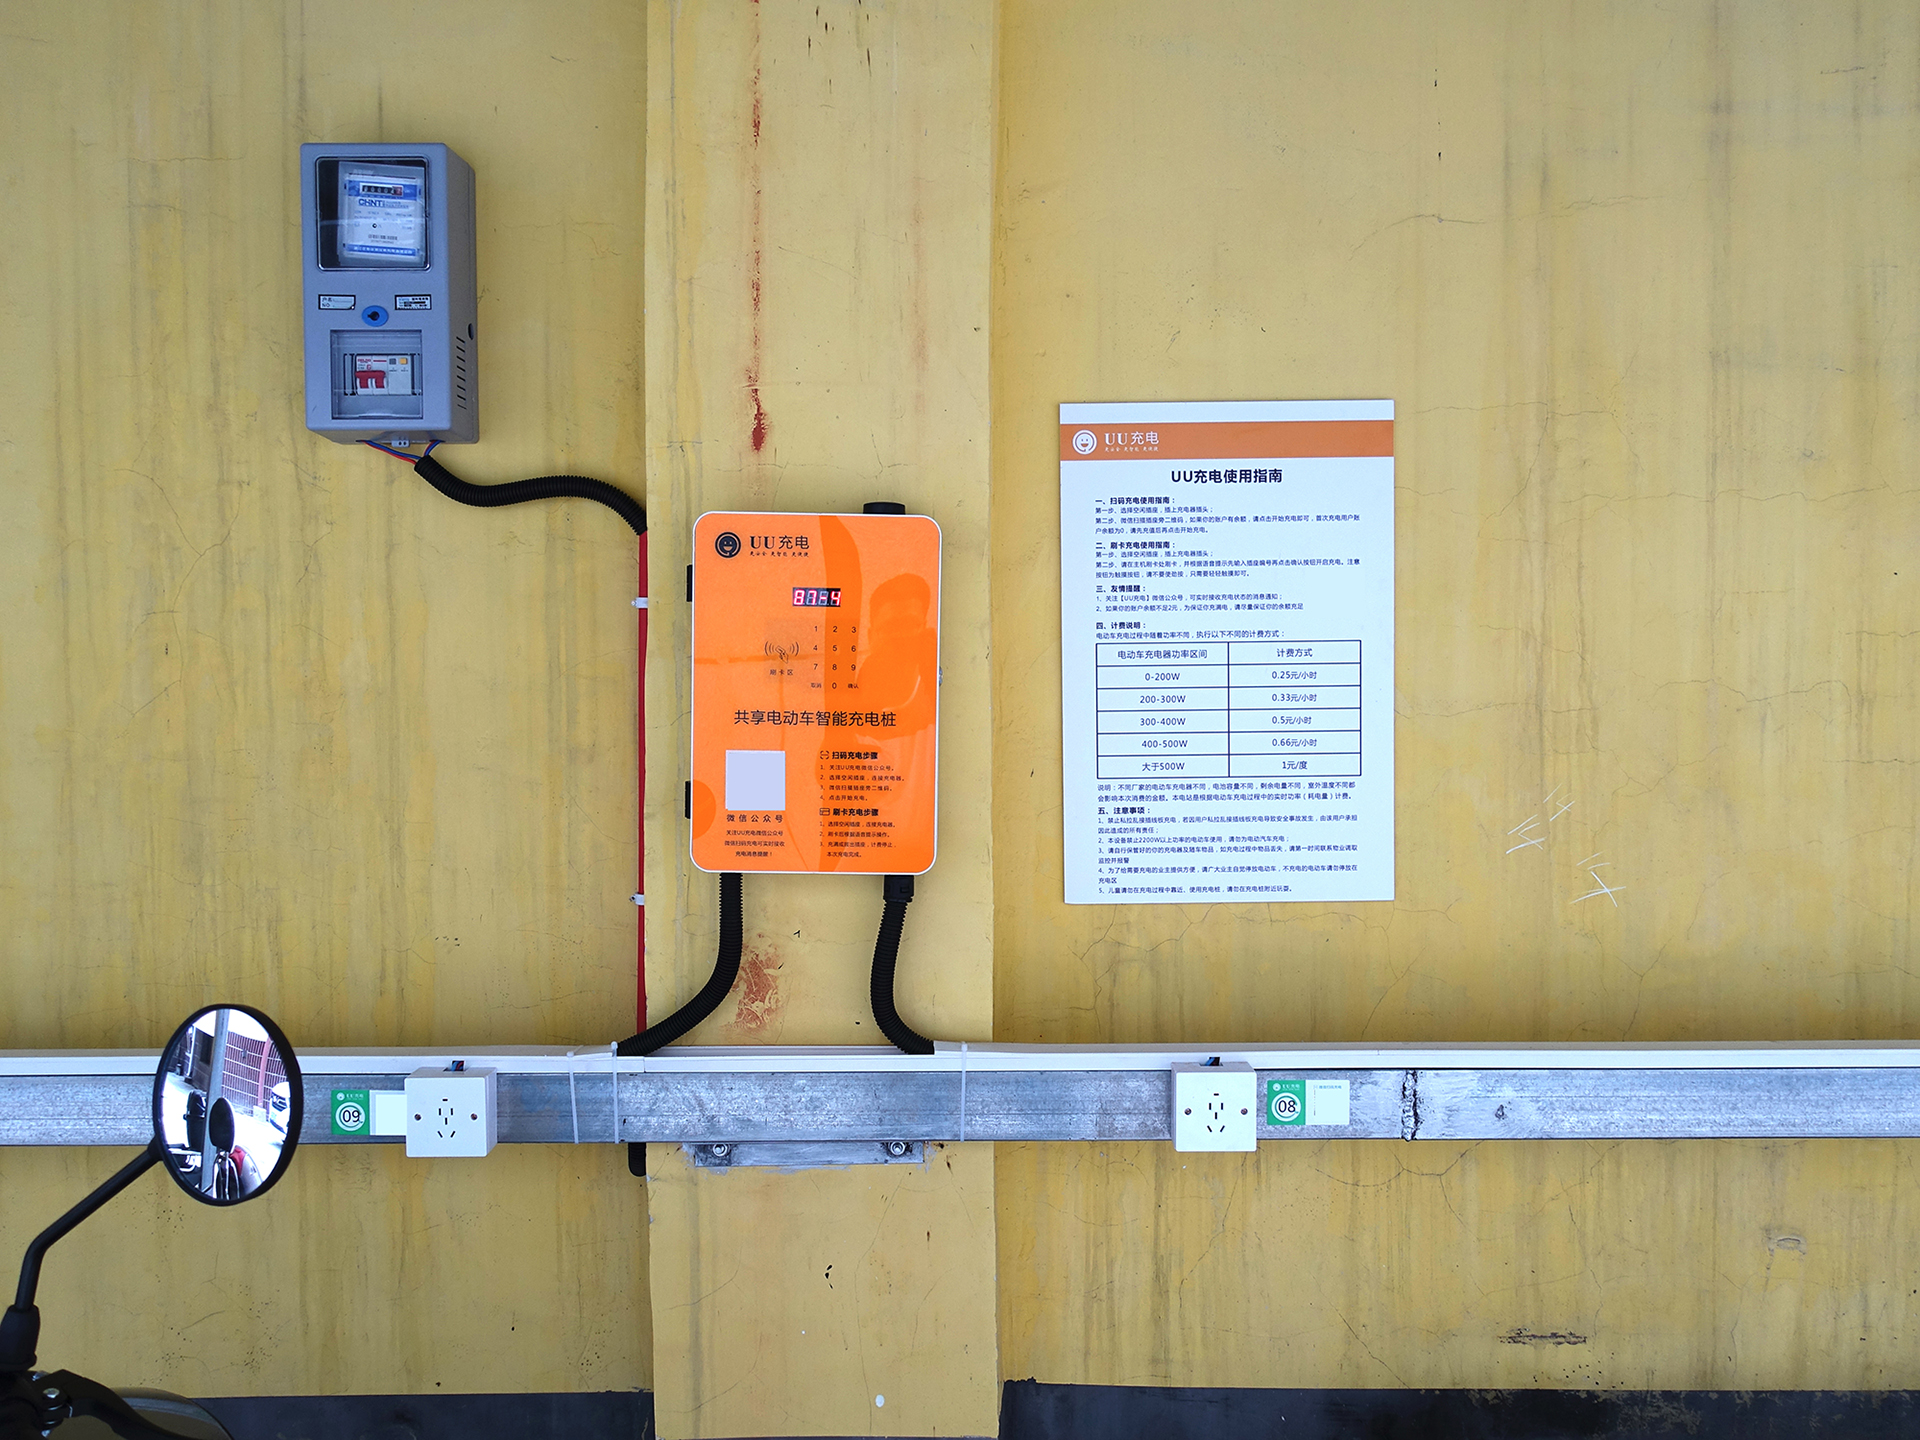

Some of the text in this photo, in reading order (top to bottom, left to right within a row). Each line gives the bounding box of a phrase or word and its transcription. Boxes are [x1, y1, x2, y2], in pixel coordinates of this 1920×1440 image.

[1104, 431, 1159, 446] UU充电
[1171, 468, 1283, 484] UU充电使用指南
[750, 535, 810, 549] UU充电
[1117, 647, 1313, 660] 电动车充电器功率区间 计费方式
[1144, 672, 1180, 681] 0-200W
[1272, 670, 1317, 681] 0.25元/小时
[1139, 695, 1186, 704] 200-300W
[1272, 692, 1317, 703] 0.33元/小时
[734, 710, 897, 727] 共享电动车智能充电桩
[1140, 717, 1186, 726] 300-400W
[1272, 715, 1312, 725] 0.5元/小时
[1141, 739, 1188, 749] 400-500W
[1272, 737, 1317, 748] 0.66元/小时
[832, 751, 878, 759] 扫码充电步骤
[1142, 761, 1185, 772] 大于500W
[1281, 760, 1308, 771] 1元/度
[727, 814, 783, 823] 微信公众号
[1278, 1100, 1296, 1113] 08
[342, 1110, 360, 1123] 09
